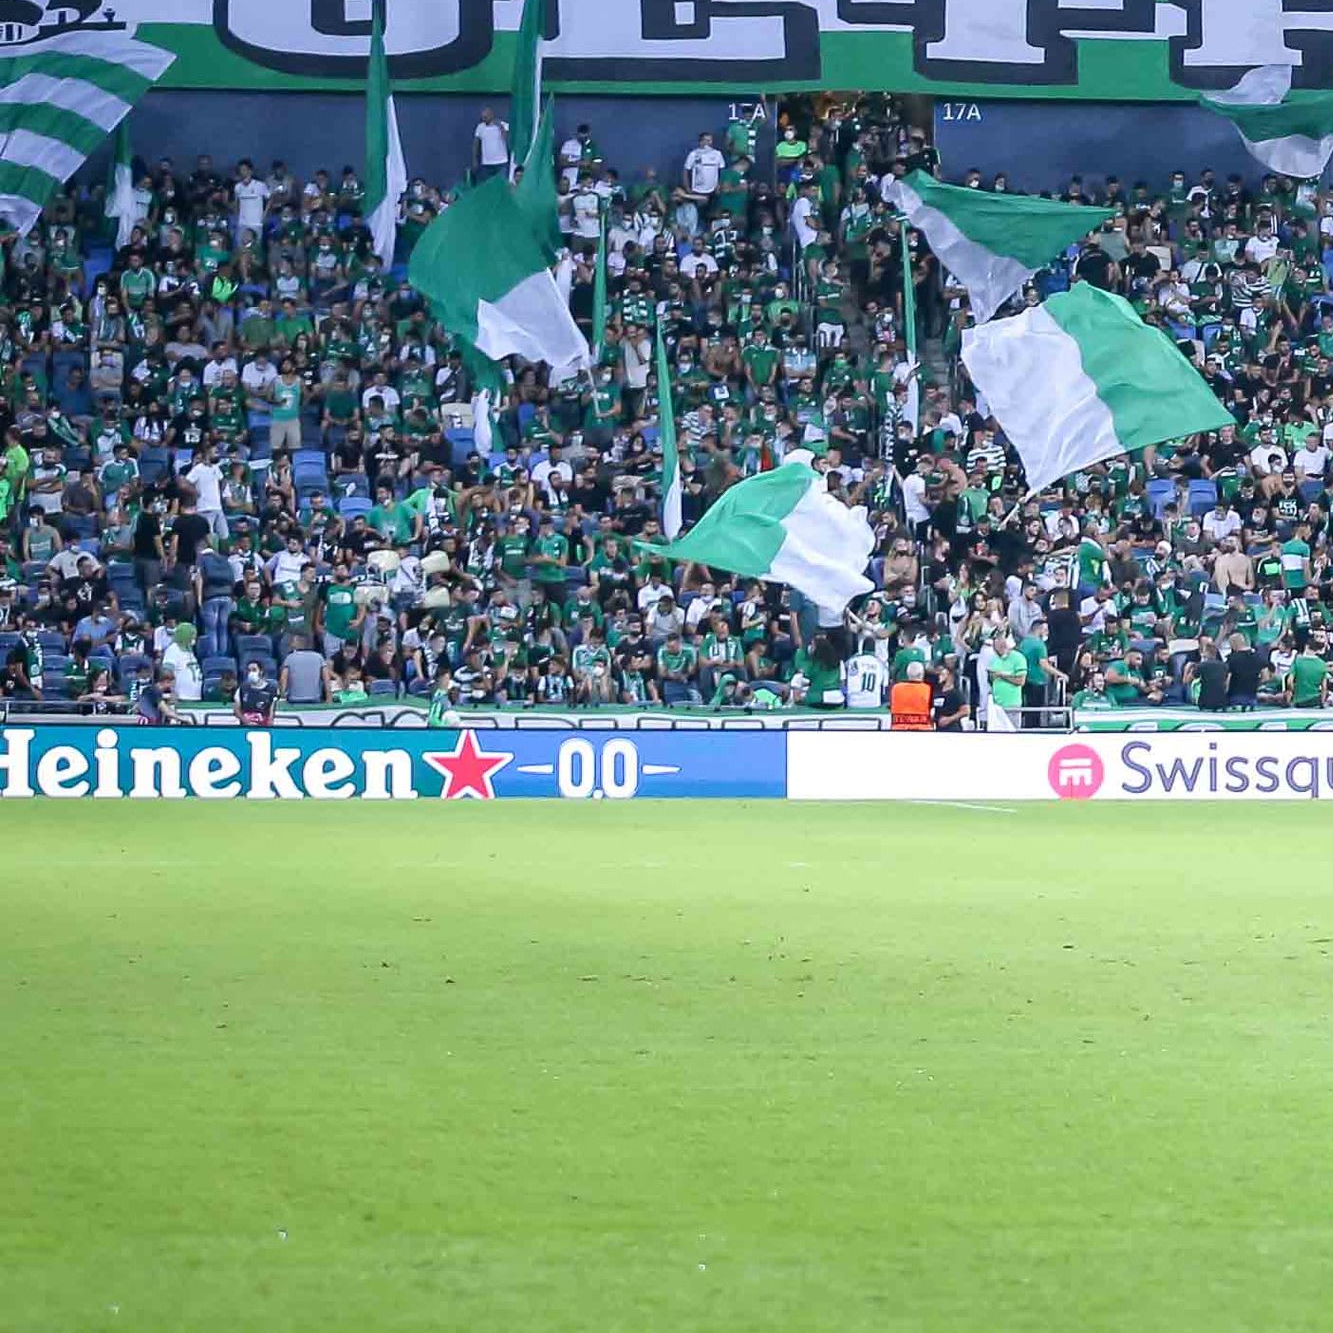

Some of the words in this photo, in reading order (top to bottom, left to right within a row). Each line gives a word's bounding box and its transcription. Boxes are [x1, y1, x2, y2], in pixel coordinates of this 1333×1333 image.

[728, 103, 766, 120] 1A
[942, 103, 982, 121] 17A
[861, 673, 876, 693] 10
[0, 729, 418, 799] Heineken
[557, 737, 640, 799] 0.0
